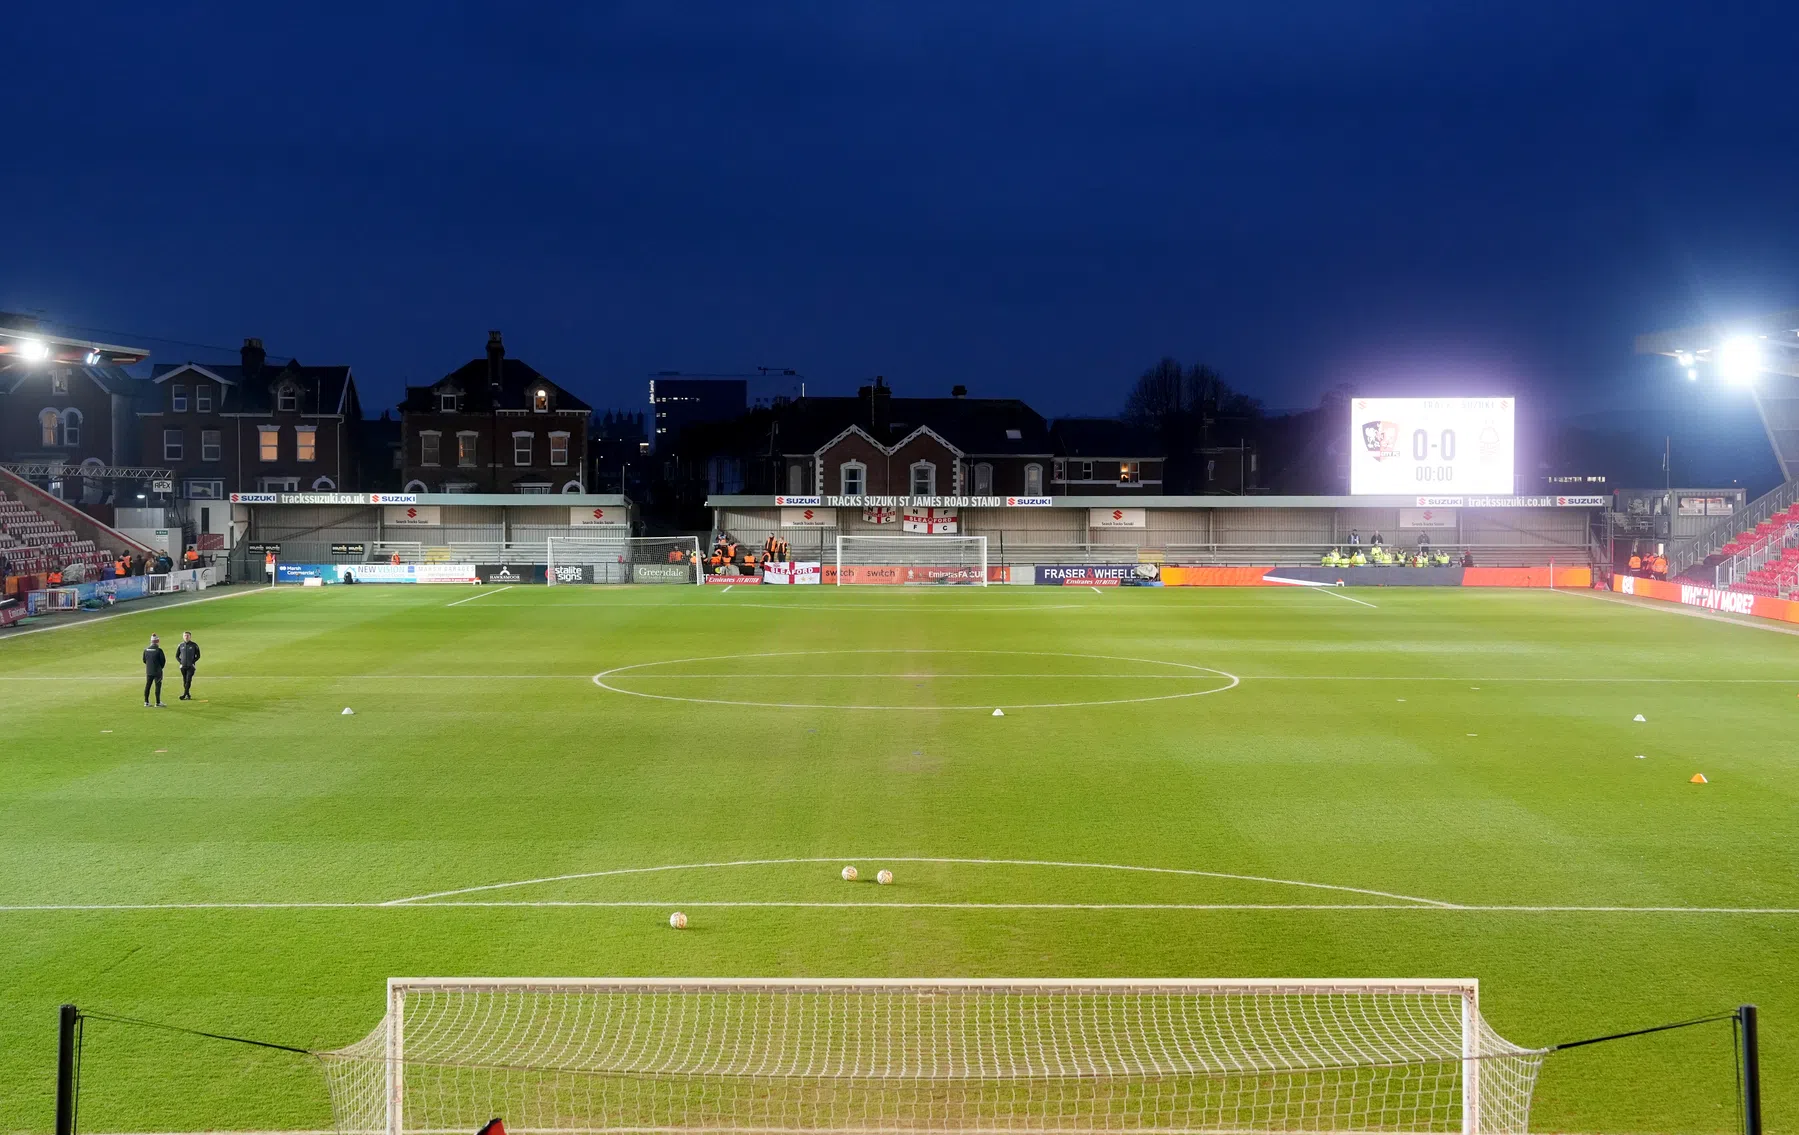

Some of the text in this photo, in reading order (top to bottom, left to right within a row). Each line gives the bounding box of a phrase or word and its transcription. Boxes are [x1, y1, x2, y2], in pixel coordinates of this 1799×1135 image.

[1416, 466, 1452, 481] 00:00
[281, 493, 364, 504] trackssuzuki.co.uk
[827, 496, 1000, 507] TRACKS SUZUKI ST JAMES ROAD STAND
[1468, 496, 1551, 507] trackssuzuki.co.uk
[558, 573, 582, 581] signs
[638, 568, 683, 577] Greendale
[1044, 568, 1138, 578] FRASER & WHEELE
[1682, 585, 1754, 614] WHY PAY MORE?
